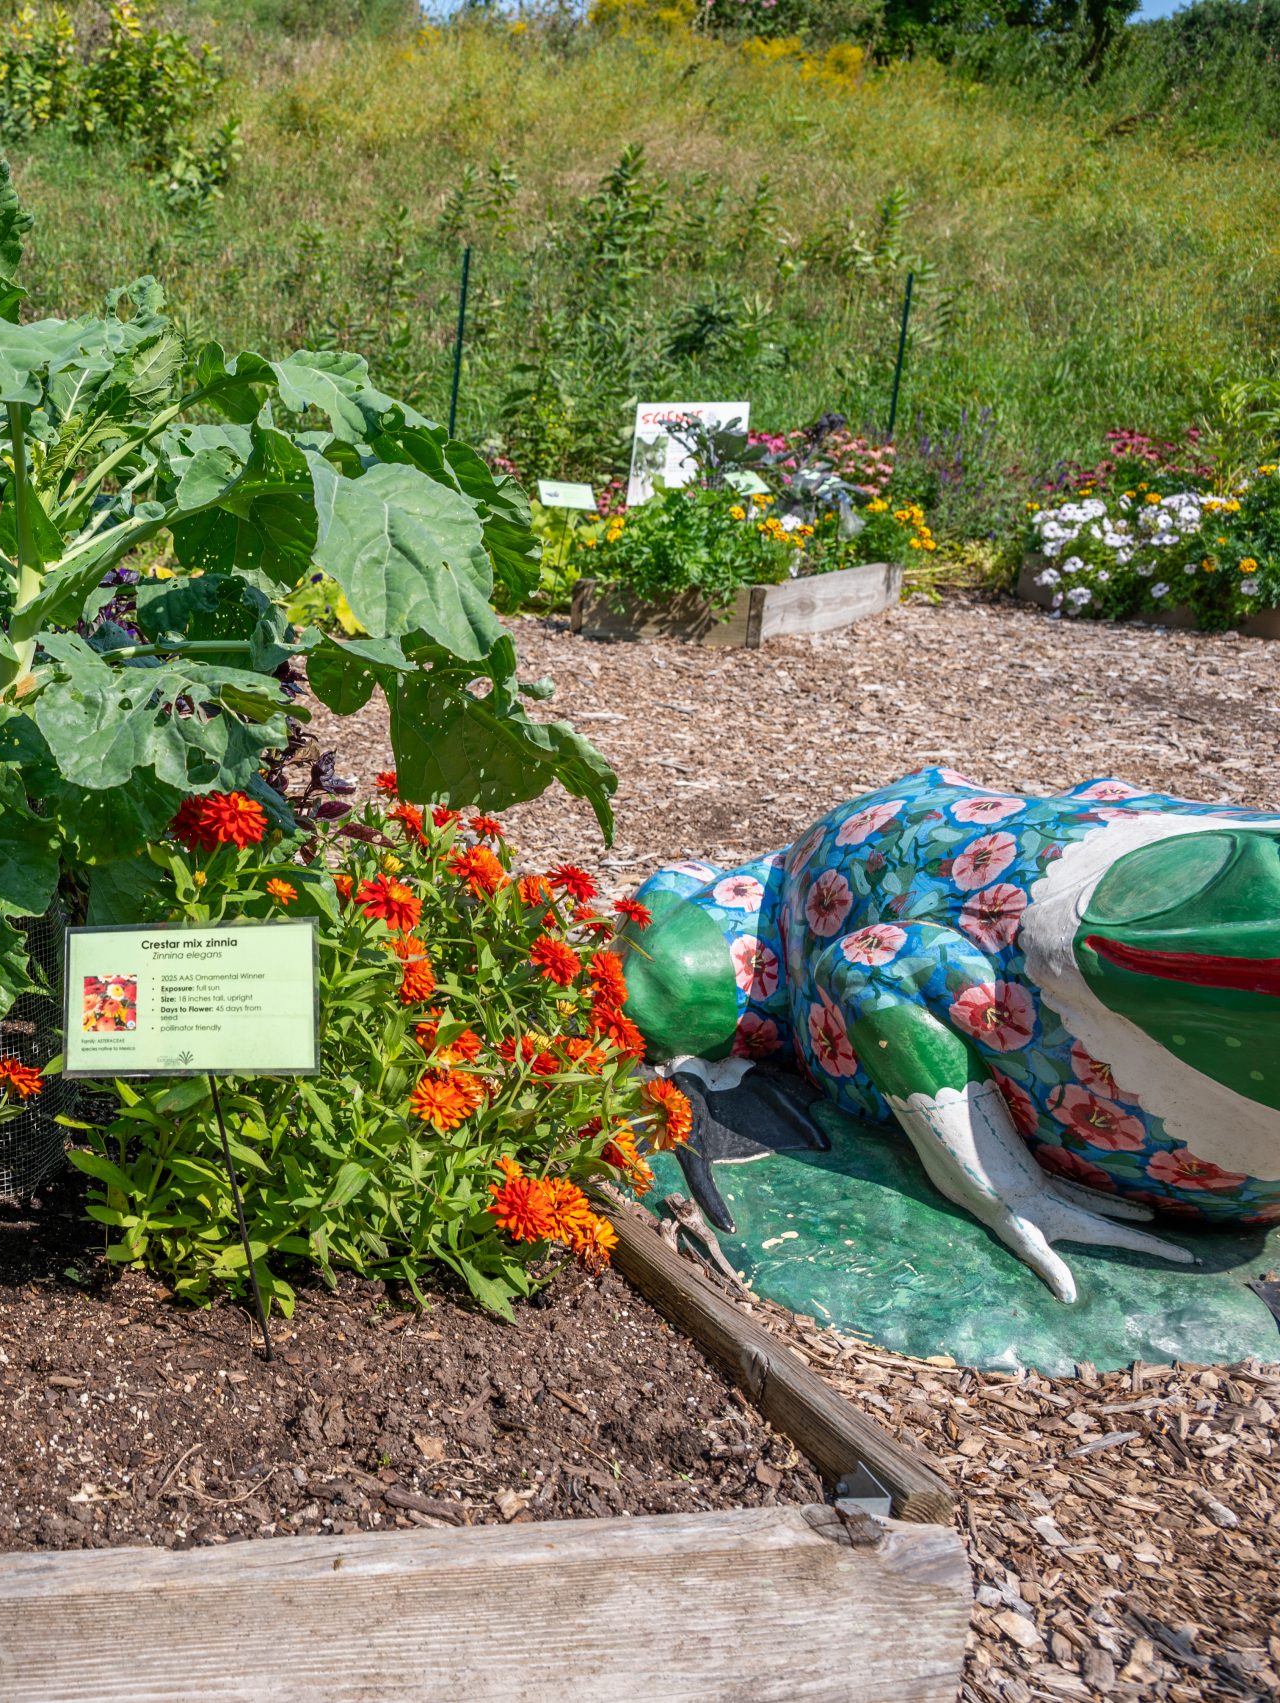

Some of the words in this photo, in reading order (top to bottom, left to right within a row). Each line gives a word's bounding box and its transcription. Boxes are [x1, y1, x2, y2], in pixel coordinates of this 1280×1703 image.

[642, 410, 703, 425] SCIEN
[141, 940, 180, 949] Crestar
[183, 938, 202, 948] mix
[206, 937, 238, 947] zinnia
[186, 951, 222, 960] elegans
[227, 994, 253, 1002] upright
